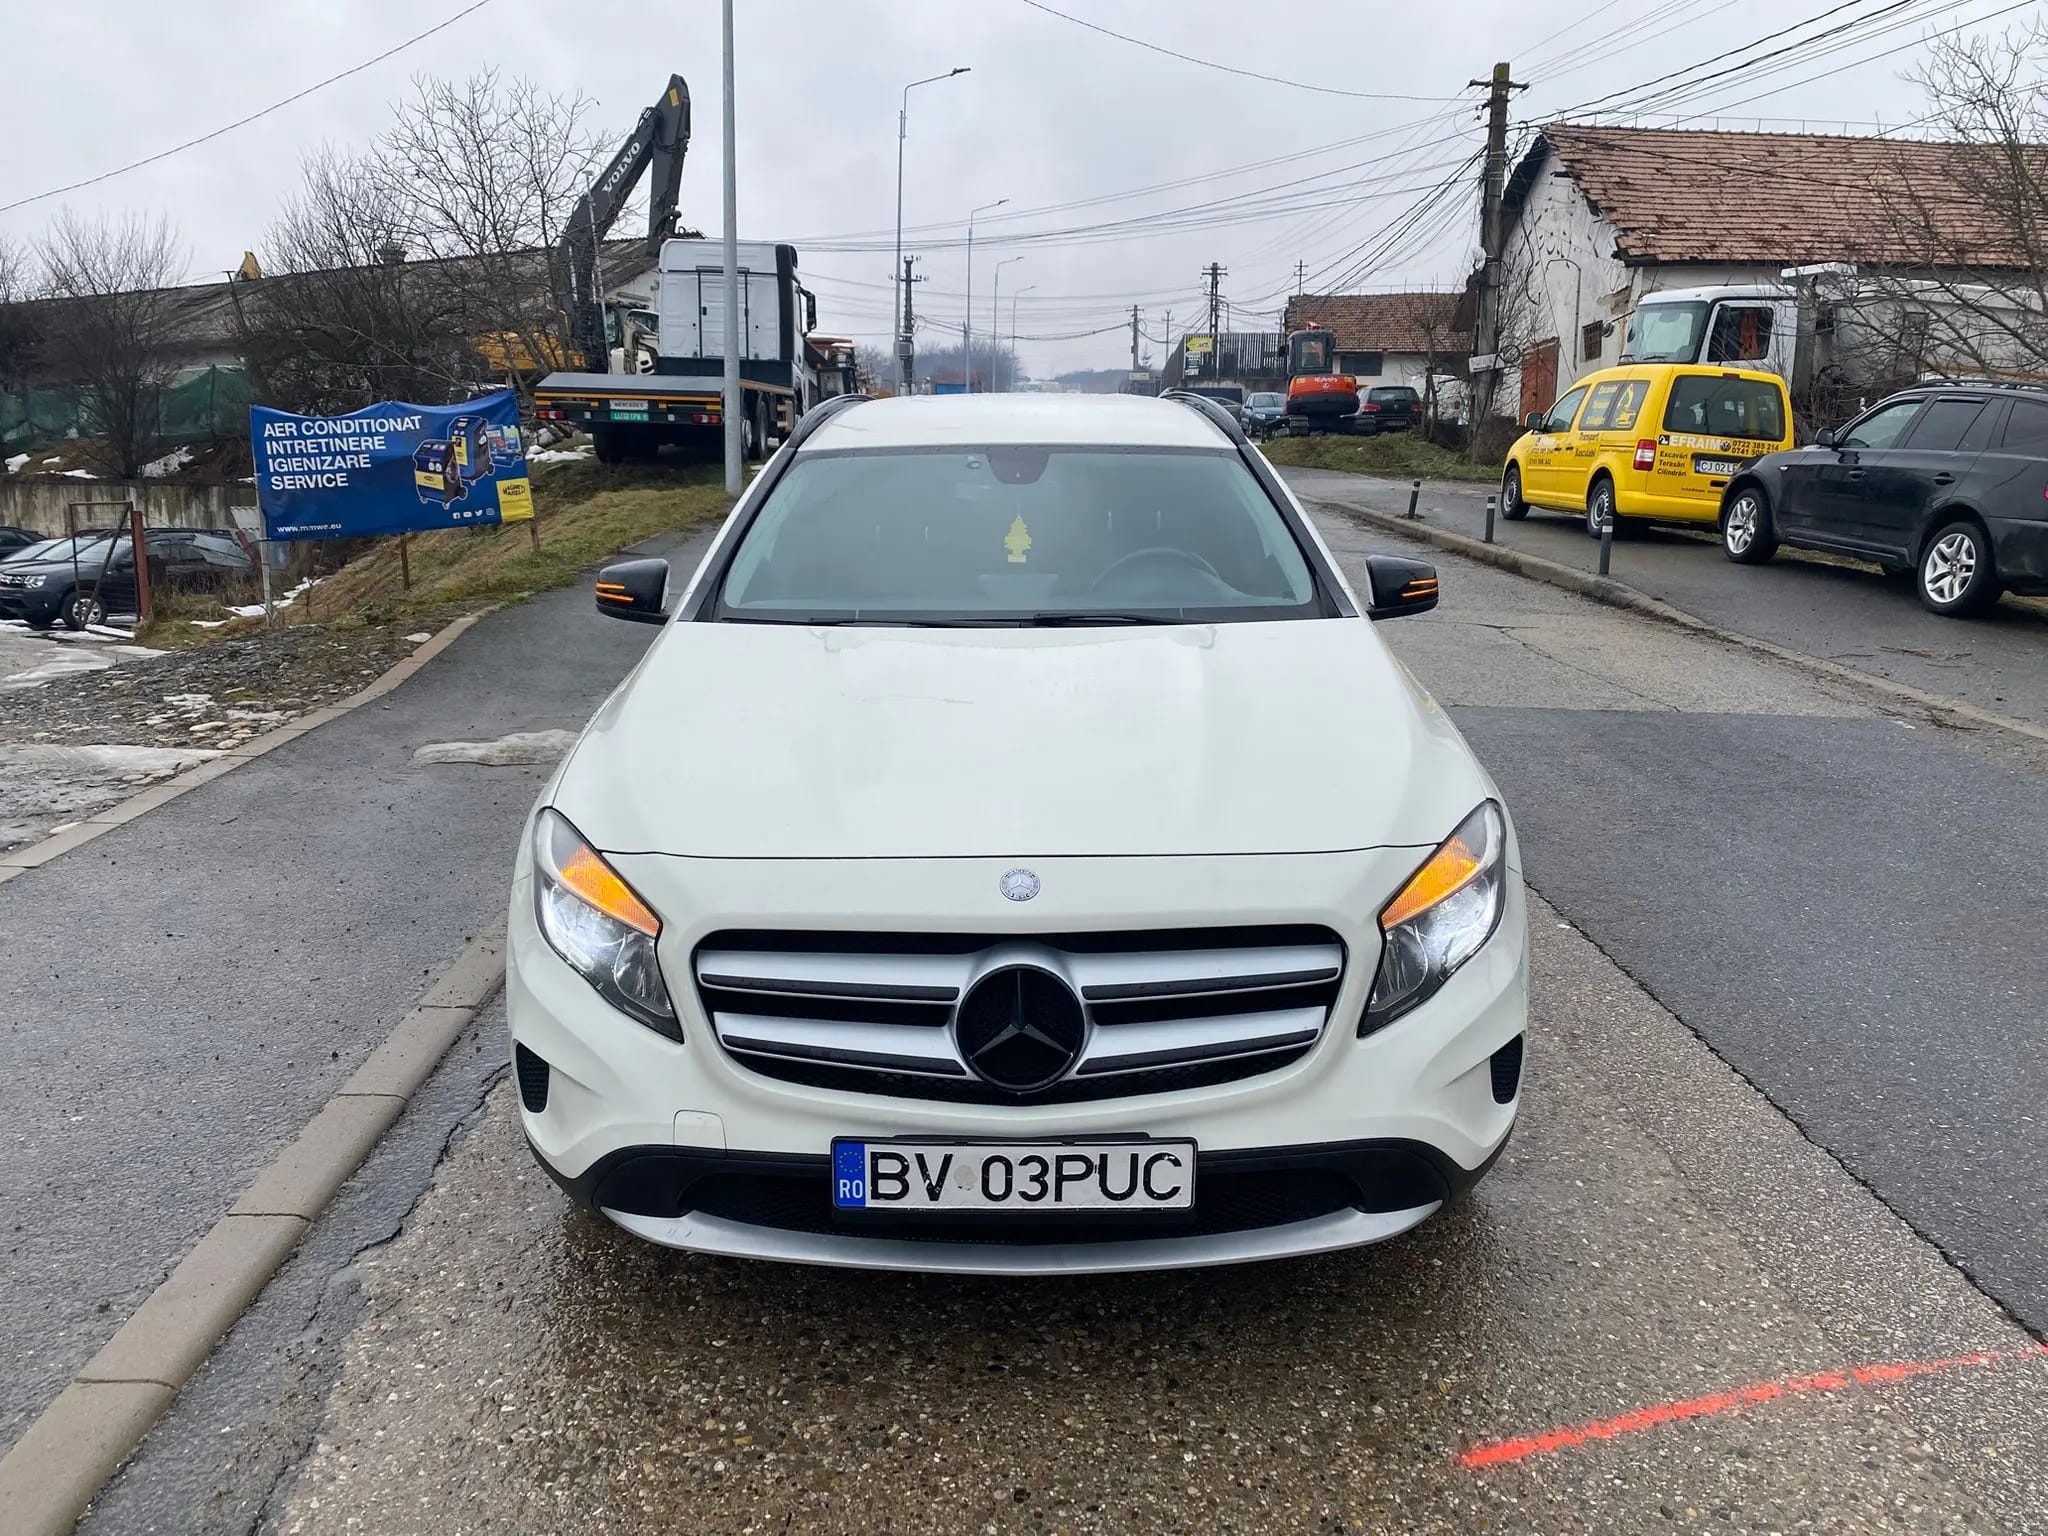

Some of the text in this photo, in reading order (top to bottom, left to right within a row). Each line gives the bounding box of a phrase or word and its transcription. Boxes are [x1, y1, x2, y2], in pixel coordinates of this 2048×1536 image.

[601, 142, 640, 192] VOLVO
[264, 415, 422, 437] AER CONDITIONAT
[266, 436, 386, 455] INTRETINERE
[1669, 435, 1721, 451] EFRAIM
[268, 454, 371, 472] IGIENIZARE
[1701, 461, 1713, 471] CJ
[1714, 462, 1726, 472] 02
[271, 473, 349, 490] SERVICE
[870, 1151, 953, 1201] BV
[840, 1180, 863, 1198] RO
